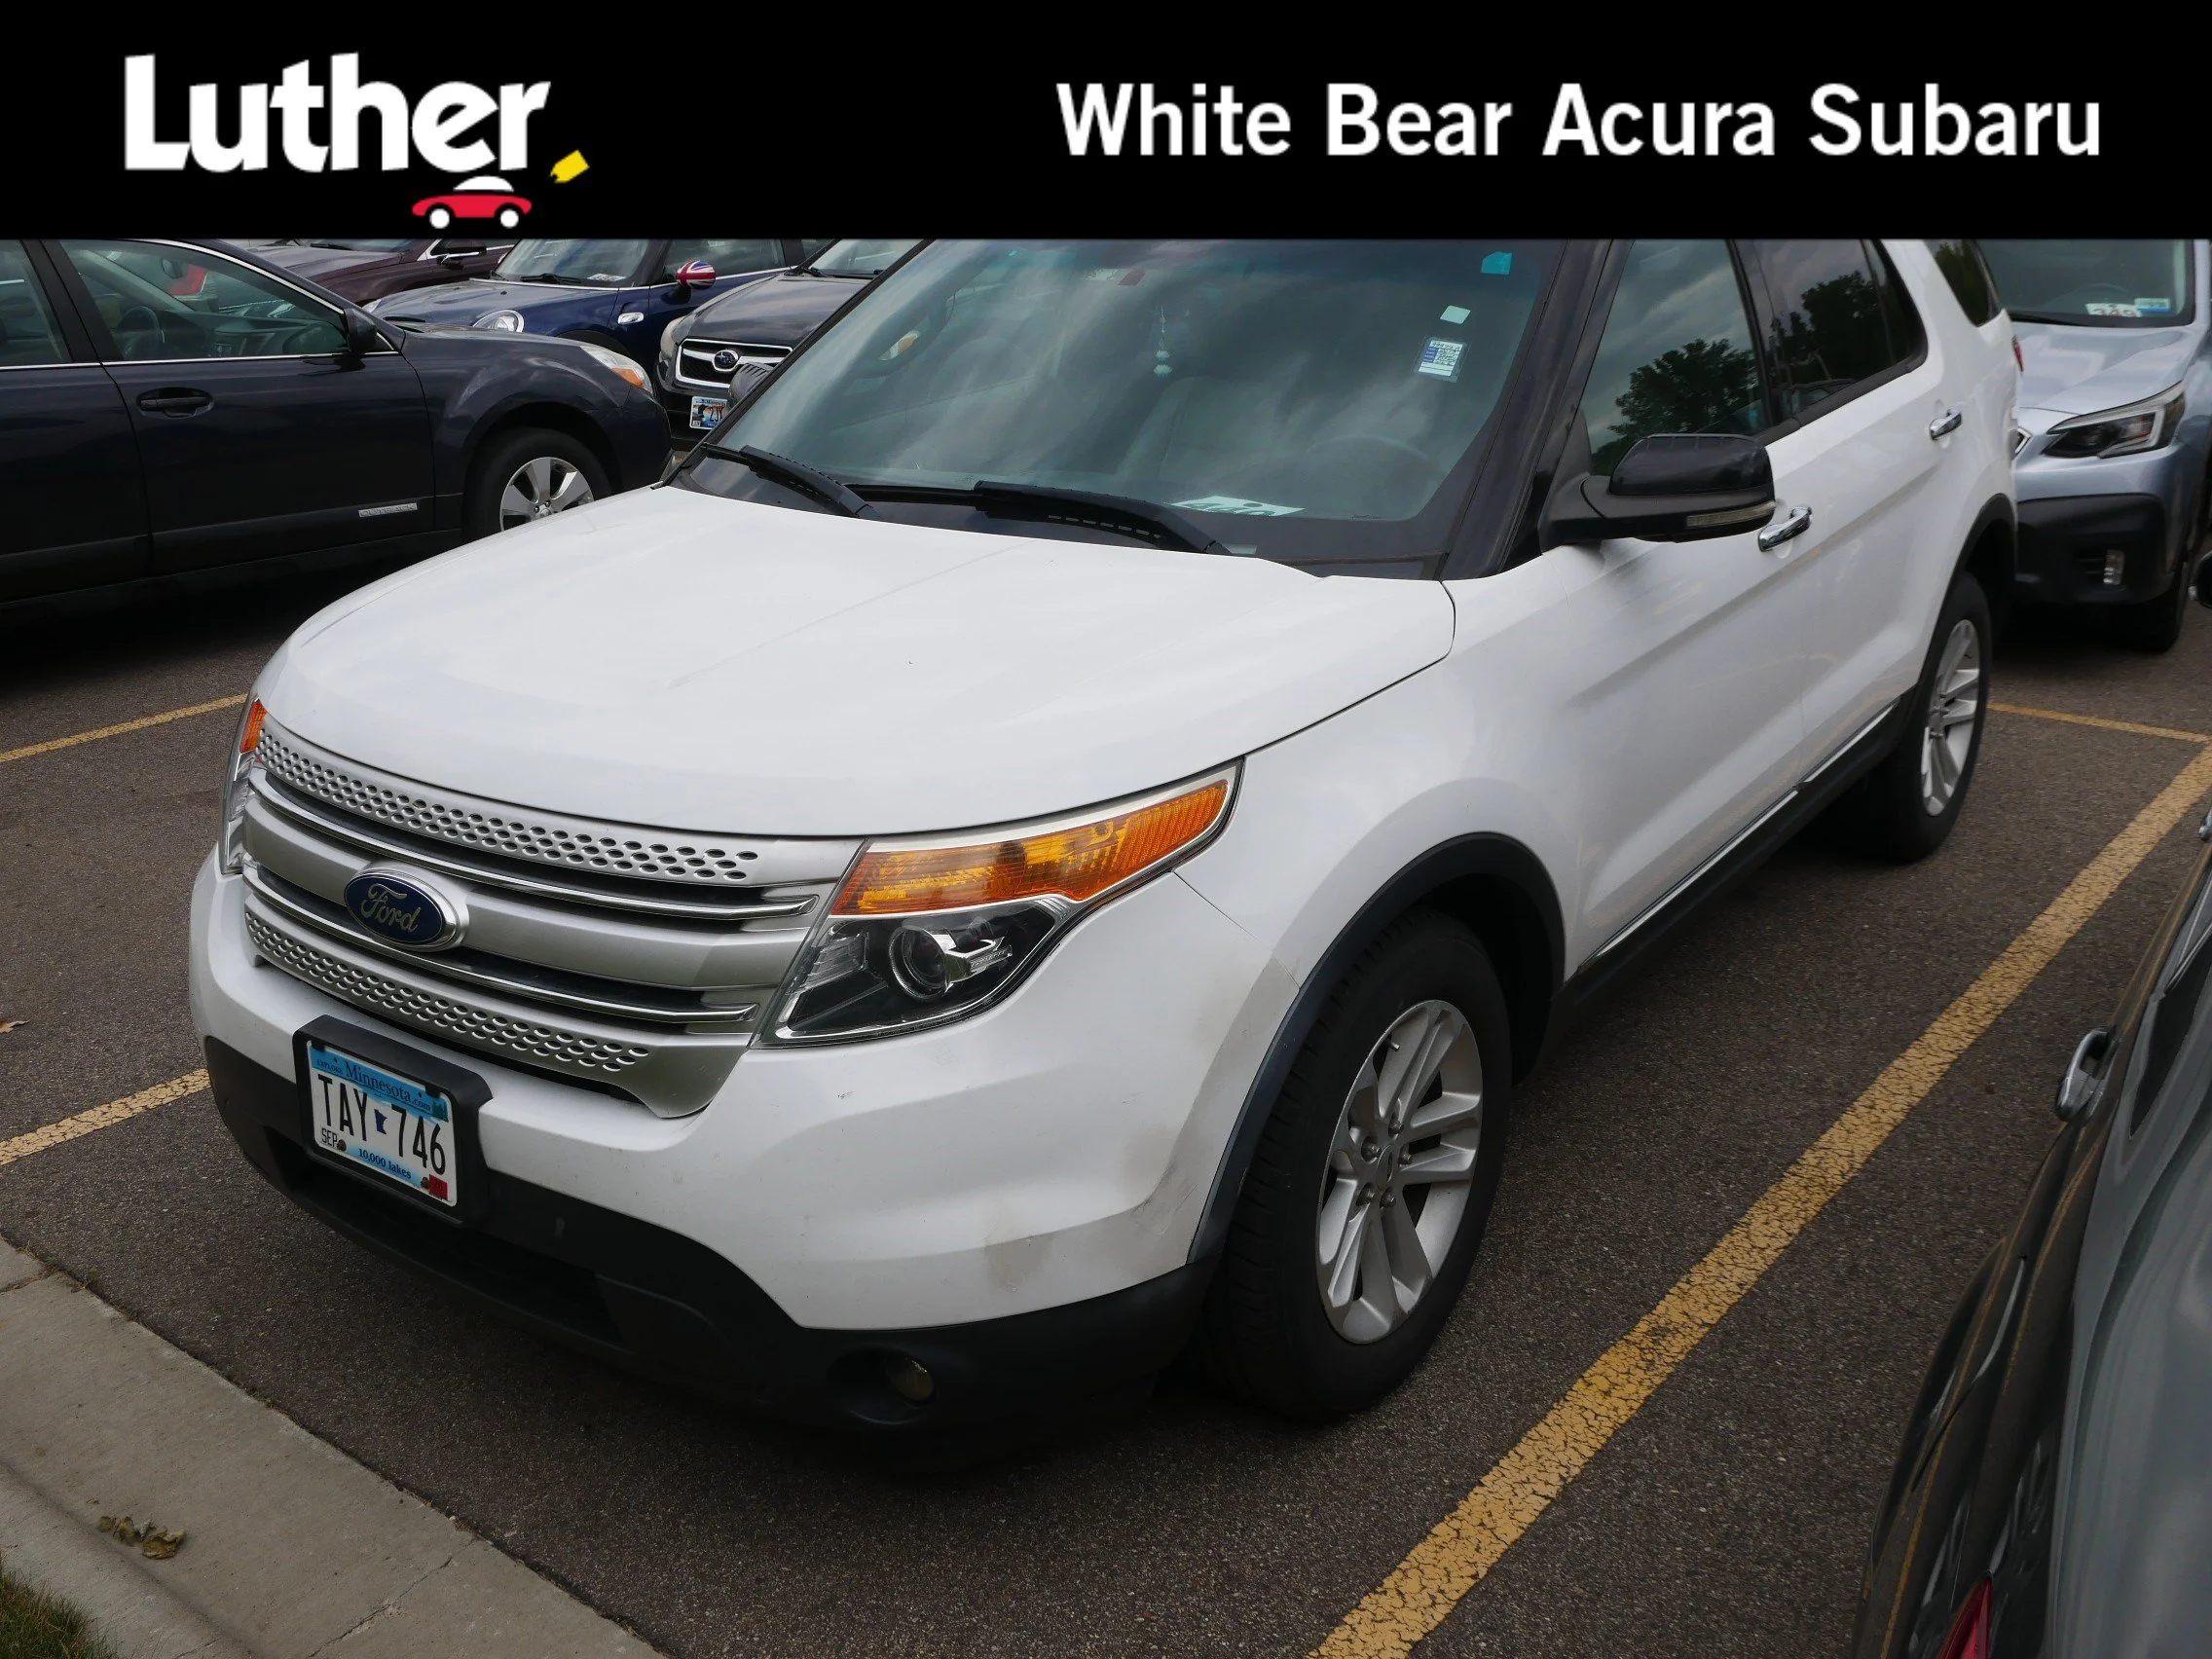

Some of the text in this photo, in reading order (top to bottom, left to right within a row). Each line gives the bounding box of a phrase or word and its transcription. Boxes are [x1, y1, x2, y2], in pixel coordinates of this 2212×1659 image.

[358, 502, 418, 517] OUTBACK
[360, 883, 422, 932] Ford
[317, 1073, 446, 1175] TAY 746
[321, 1127, 338, 1148] SEP
[358, 1148, 412, 1180] 10,000 lakes
